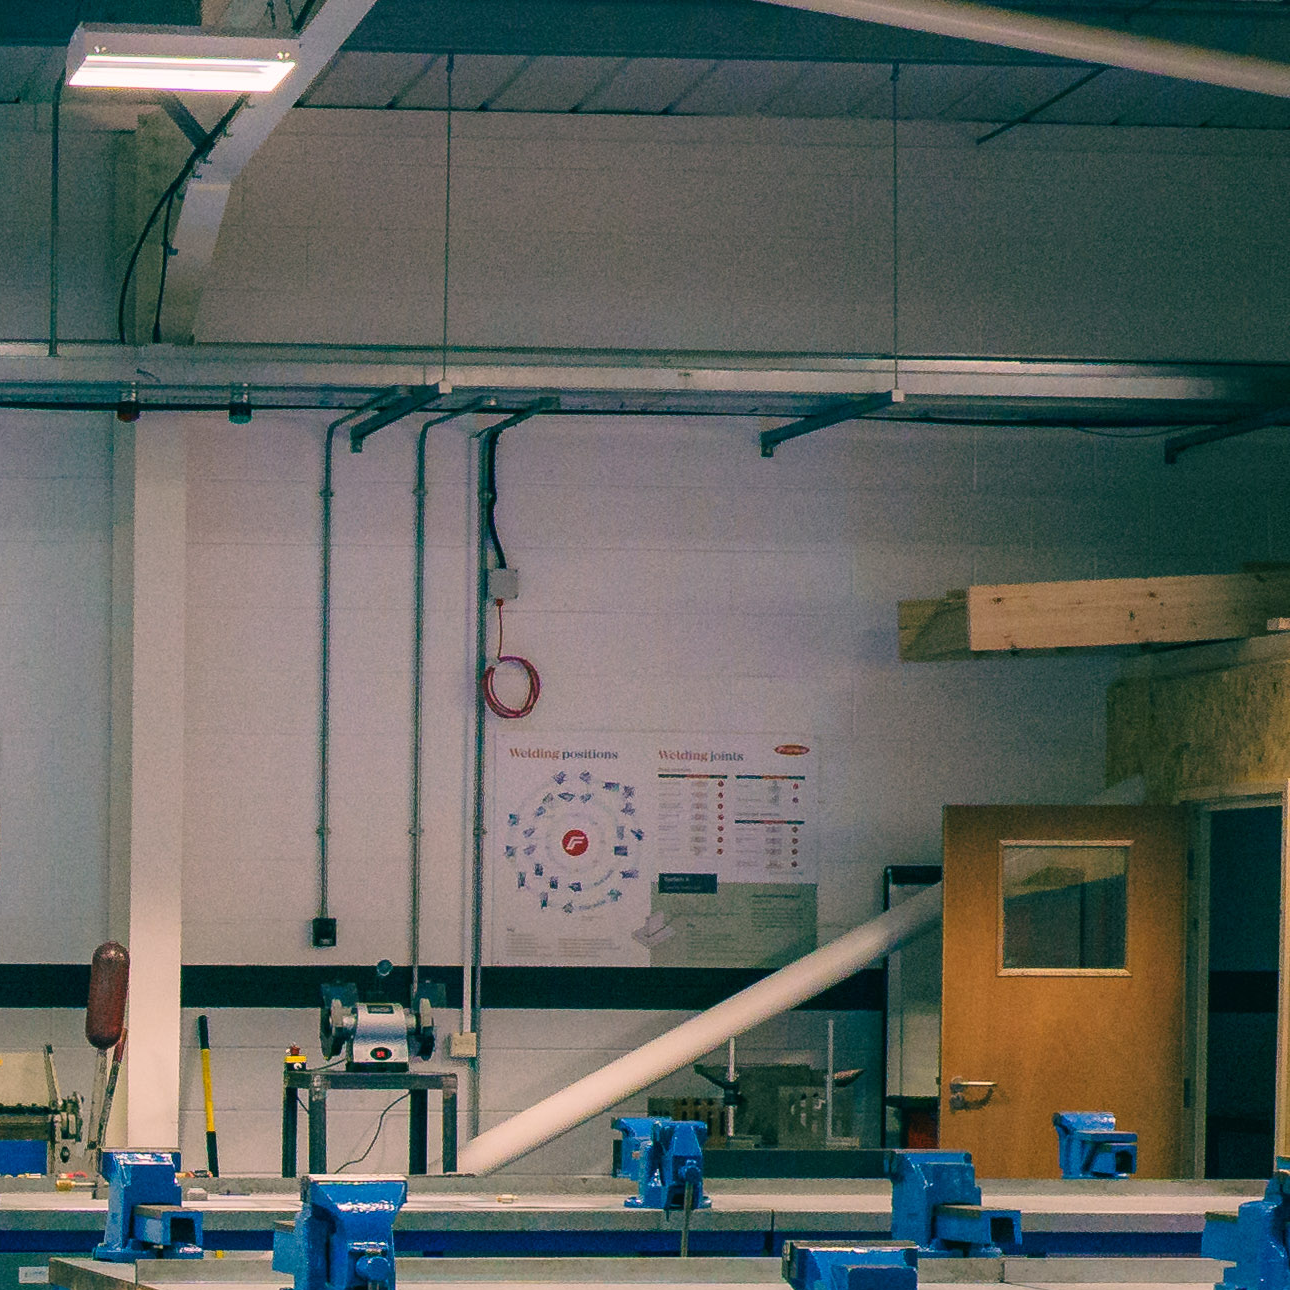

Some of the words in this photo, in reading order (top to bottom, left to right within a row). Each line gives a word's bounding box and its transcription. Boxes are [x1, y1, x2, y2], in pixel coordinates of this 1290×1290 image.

[509, 748, 560, 760] Welding
[561, 749, 619, 760] positions
[658, 750, 708, 762] Welding
[709, 751, 744, 762] joints
